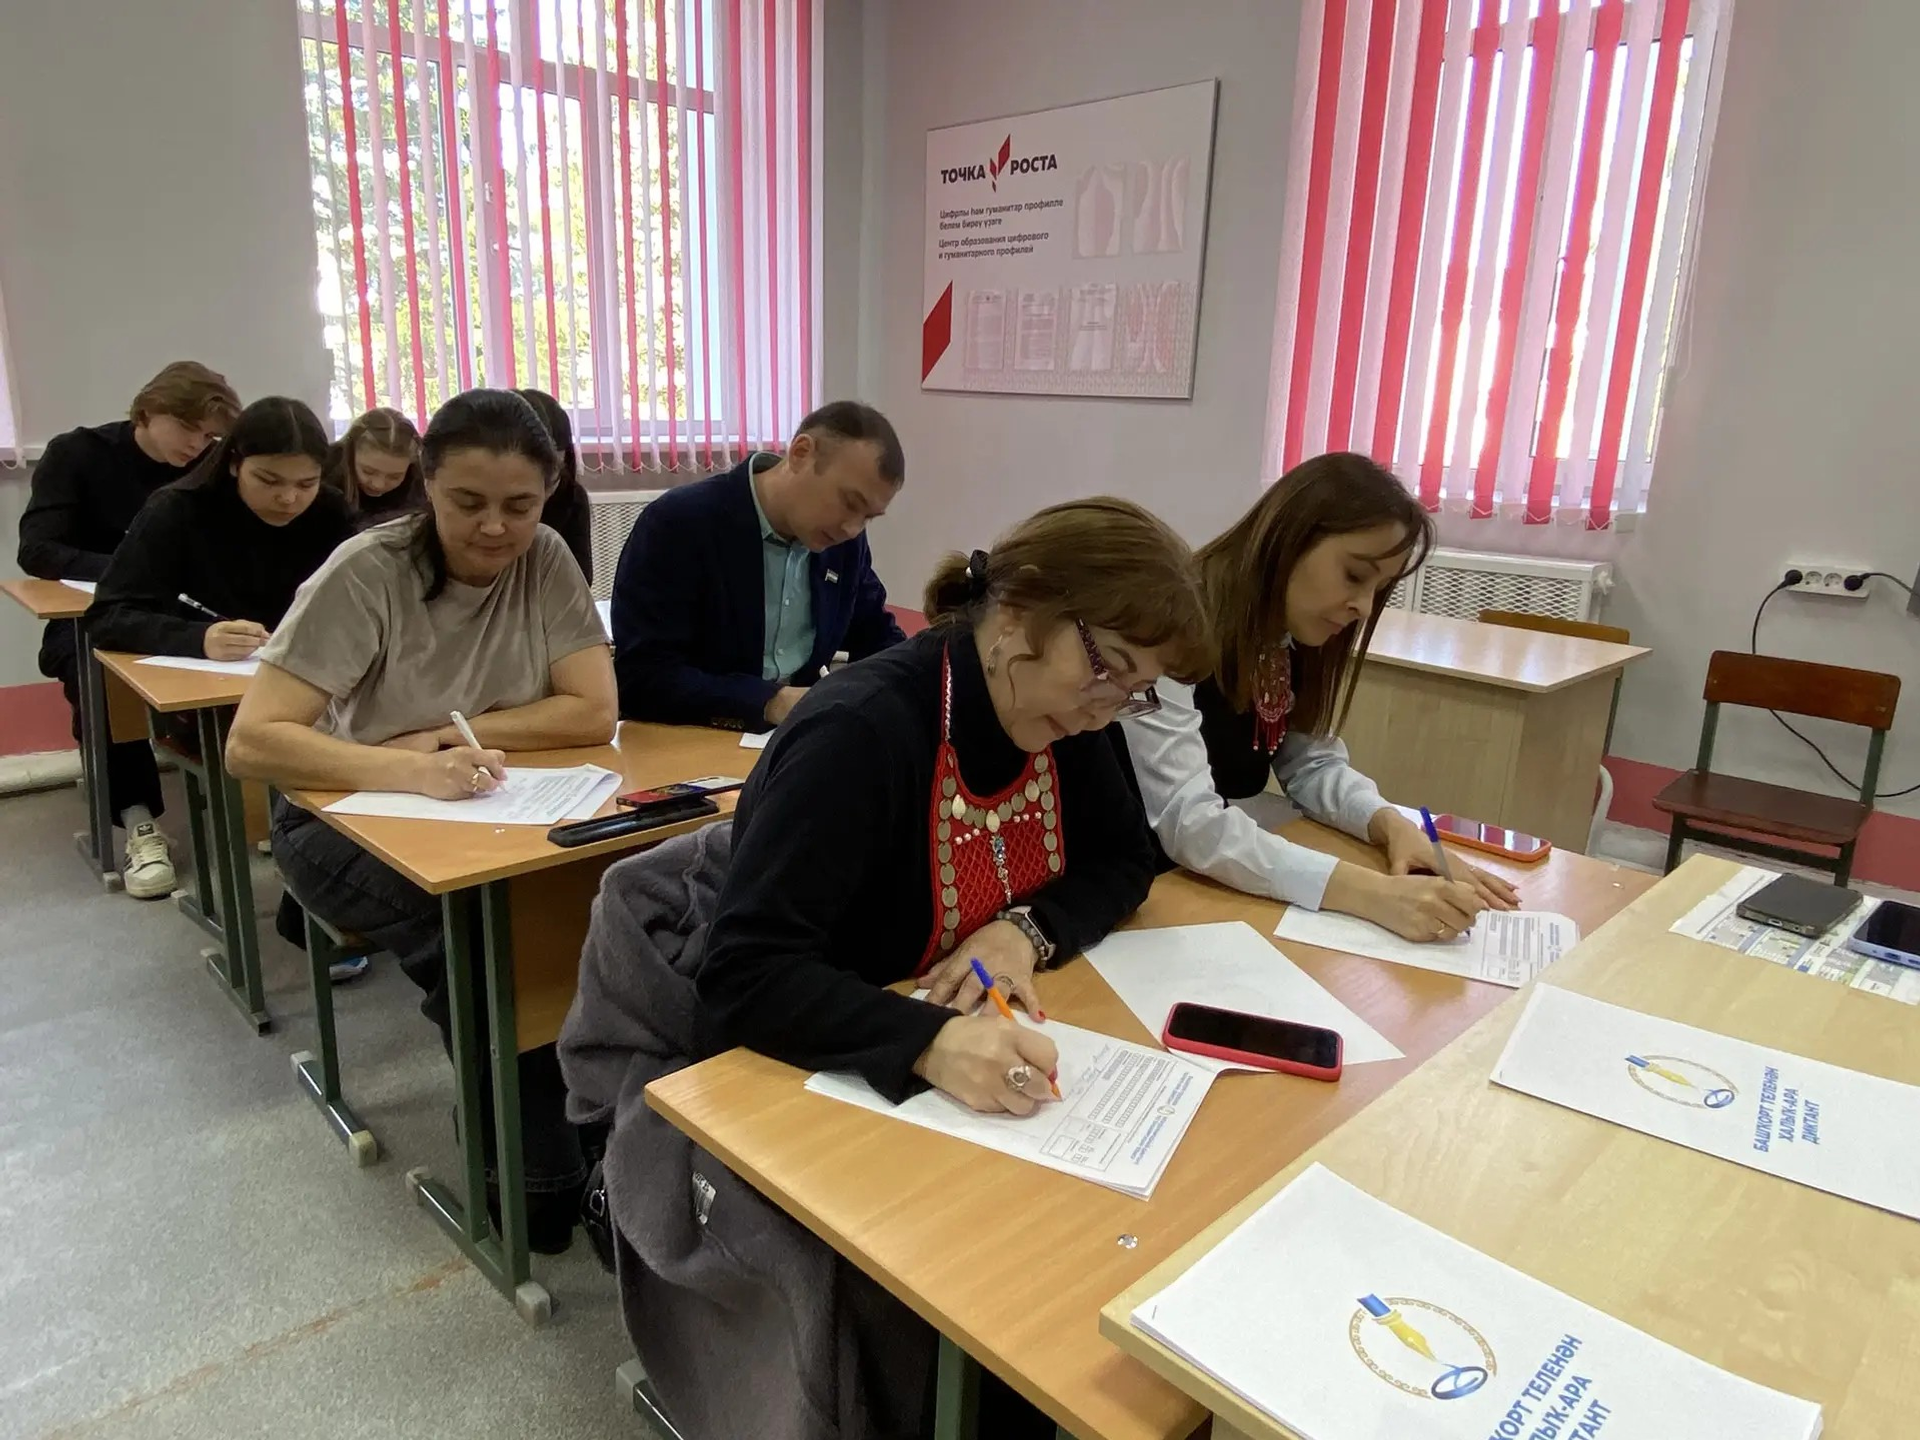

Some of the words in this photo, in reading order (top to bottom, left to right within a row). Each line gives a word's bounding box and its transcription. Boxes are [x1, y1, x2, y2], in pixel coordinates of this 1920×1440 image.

[941, 164, 986, 184] ТОЧКА
[1010, 154, 1058, 175] РОСТА
[985, 204, 1022, 216] гуманитар
[939, 239, 959, 248] Центр
[961, 236, 1006, 247] образования
[1007, 232, 1049, 243] цифрового
[944, 249, 994, 260] гуманитарного
[996, 245, 1034, 256] профилей
[1801, 1099, 1820, 1145] ДИКТАНТ
[1521, 1334, 1583, 1402] ТЕЛЕНӘН
